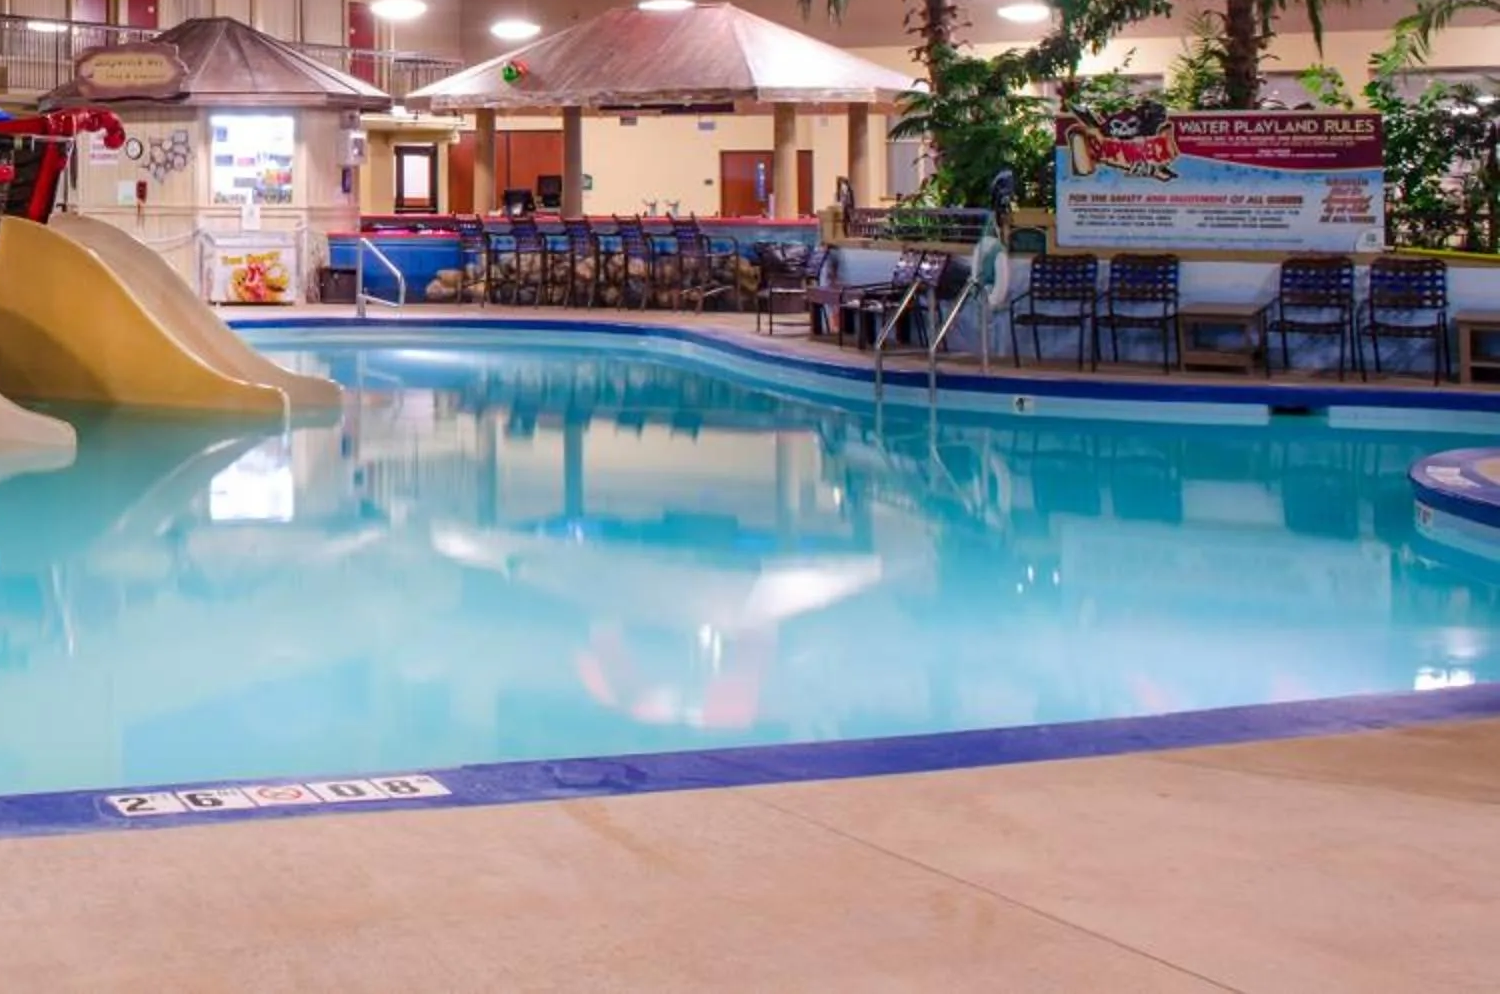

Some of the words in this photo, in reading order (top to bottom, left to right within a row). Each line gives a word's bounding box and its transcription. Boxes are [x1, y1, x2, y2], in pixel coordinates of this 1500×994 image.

[1178, 119, 1230, 134] WATER
[1234, 119, 1319, 134] PLAYLAND
[1324, 119, 1375, 133] RULES
[1069, 193, 1088, 203] FOR
[381, 780, 421, 794] 8
[118, 797, 156, 812] 2
[185, 793, 223, 807] 6
